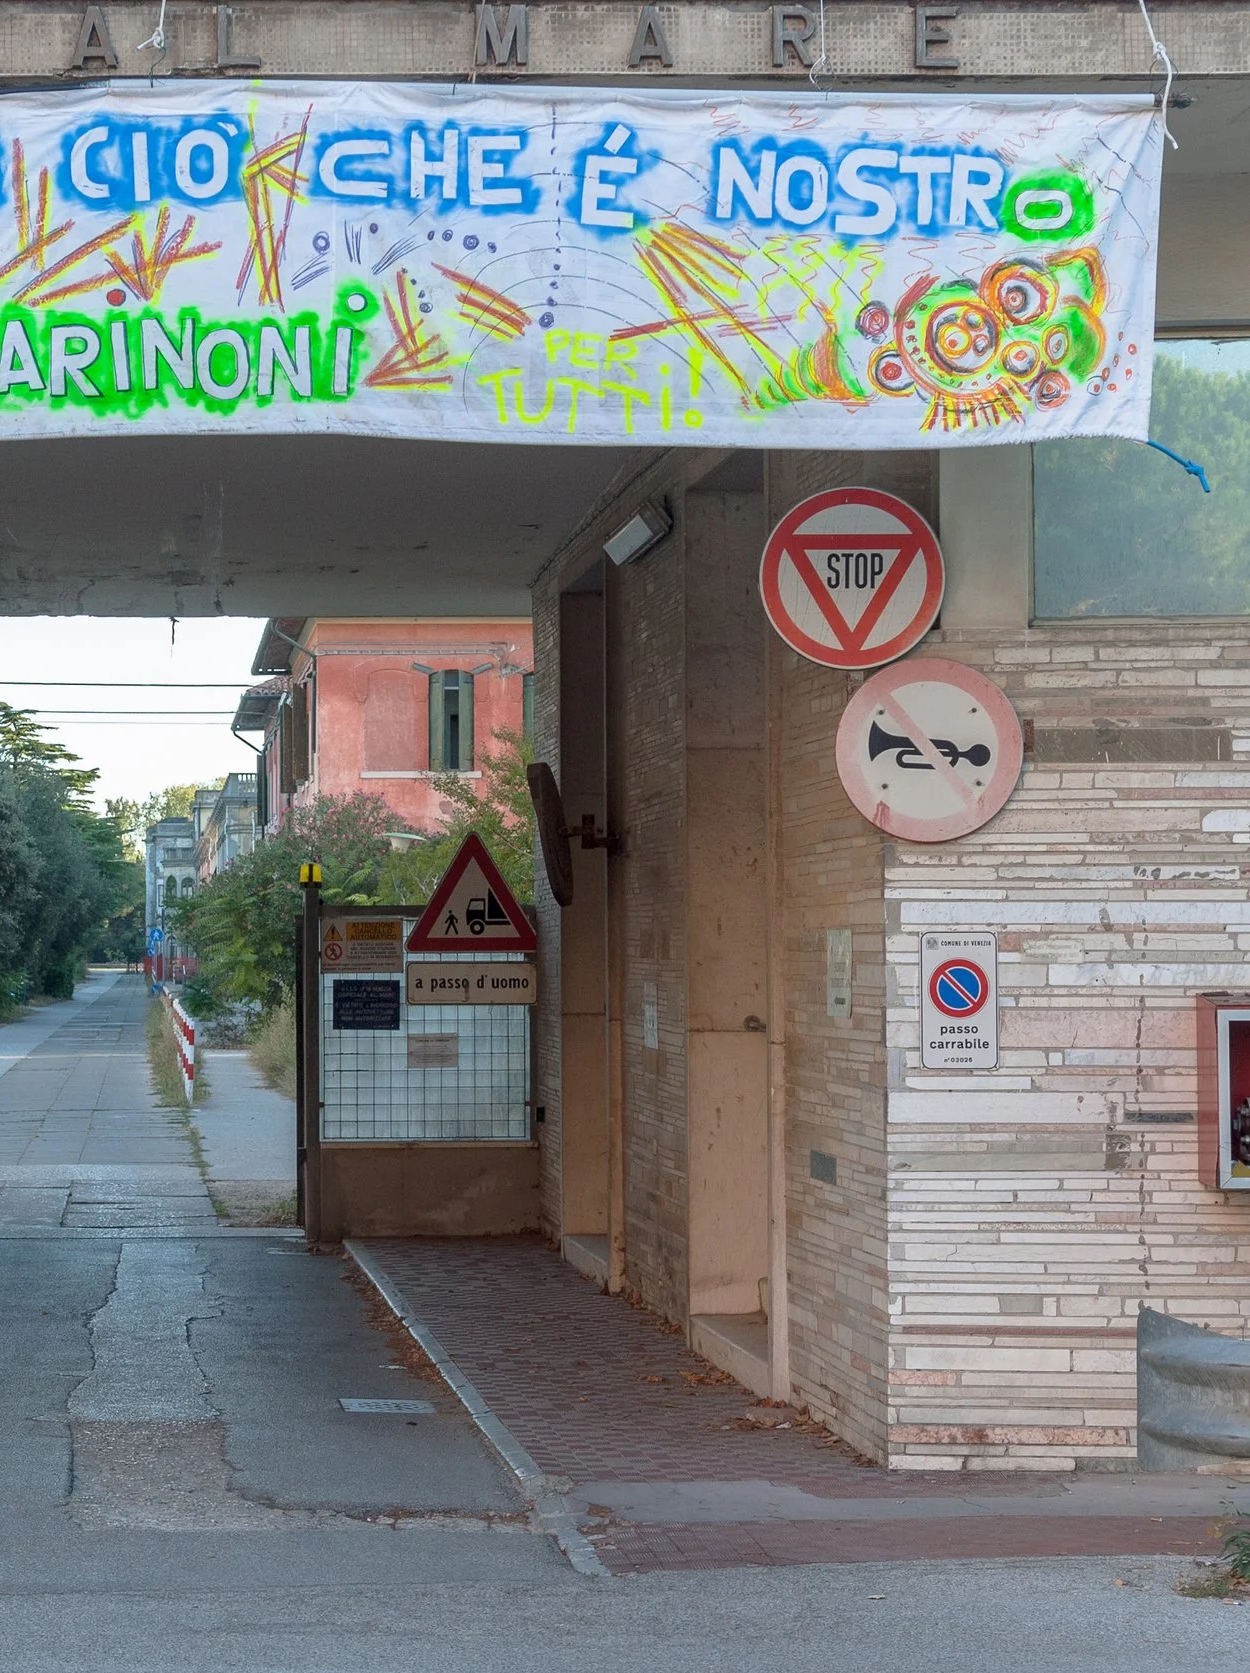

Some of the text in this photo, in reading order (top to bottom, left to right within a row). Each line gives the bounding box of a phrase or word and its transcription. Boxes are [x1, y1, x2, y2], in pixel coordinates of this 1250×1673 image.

[71, 5, 262, 69] AL
[476, 5, 959, 69] MARE
[318, 129, 524, 206] CHE
[716, 146, 1074, 237] NOSTRO
[544, 331, 639, 377] PER
[827, 553, 883, 589] STOP
[415, 977, 423, 989] a
[431, 977, 469, 992] passo
[929, 1038, 990, 1050] carrabile
[940, 1025, 979, 1036] passo
